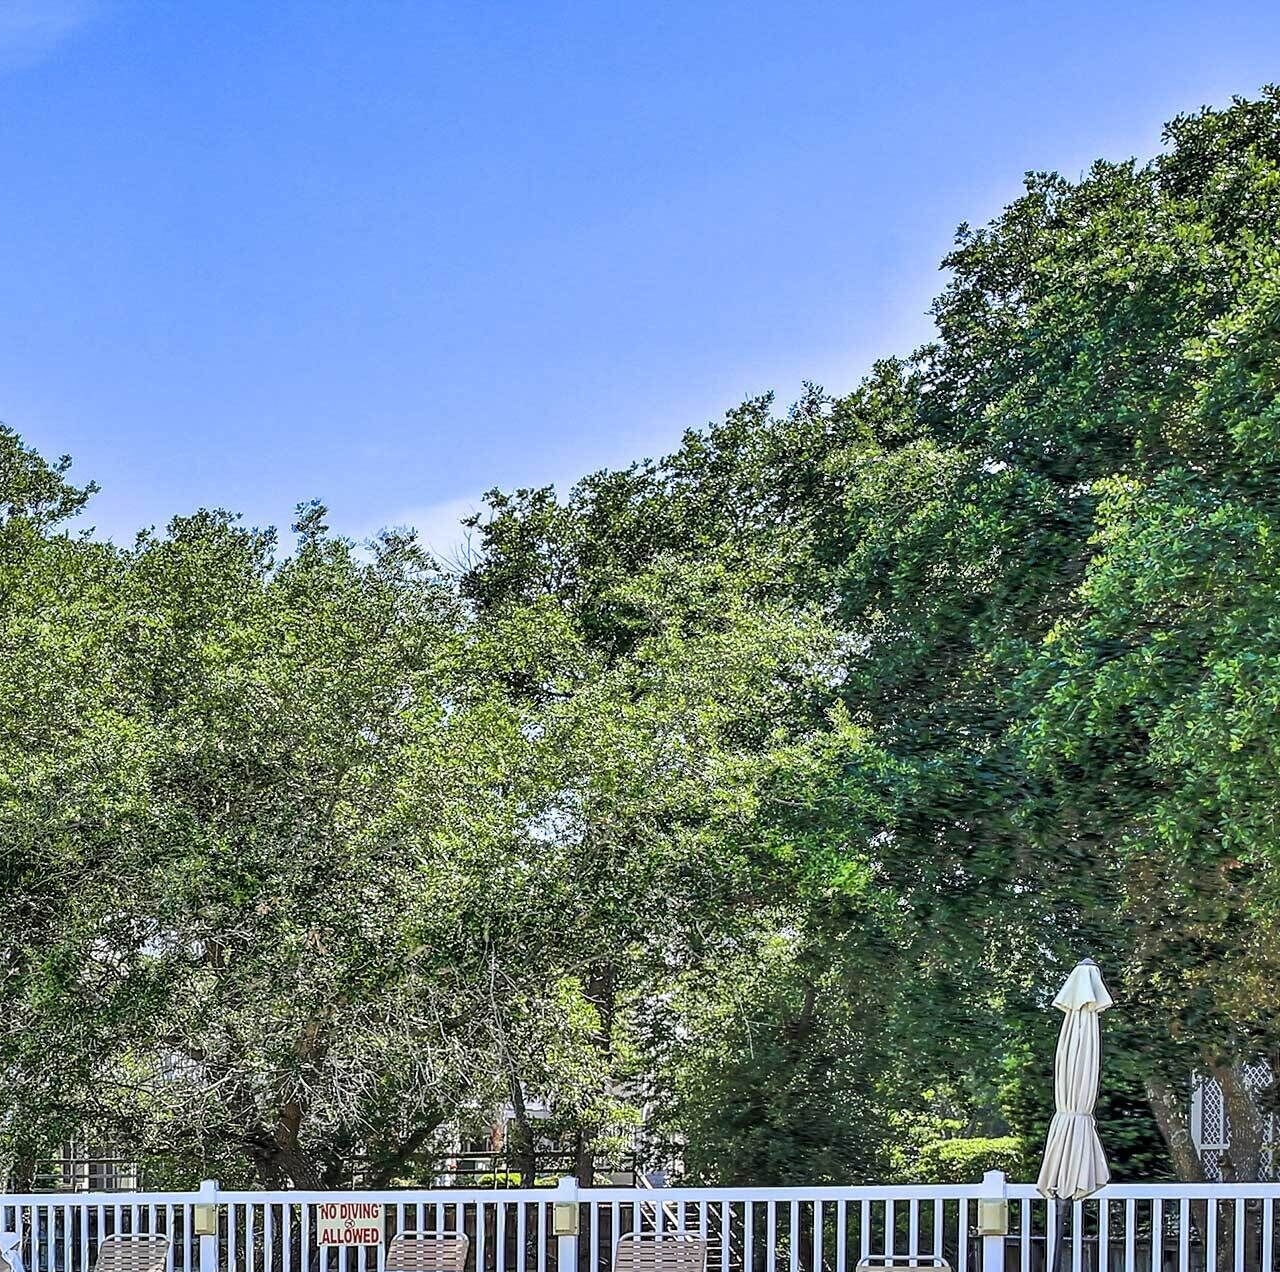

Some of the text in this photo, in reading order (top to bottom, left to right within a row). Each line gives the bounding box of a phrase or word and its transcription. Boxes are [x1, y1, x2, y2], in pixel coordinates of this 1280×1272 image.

[321, 1203, 379, 1219] NO DIVING
[322, 1228, 379, 1244] ALLOWED
